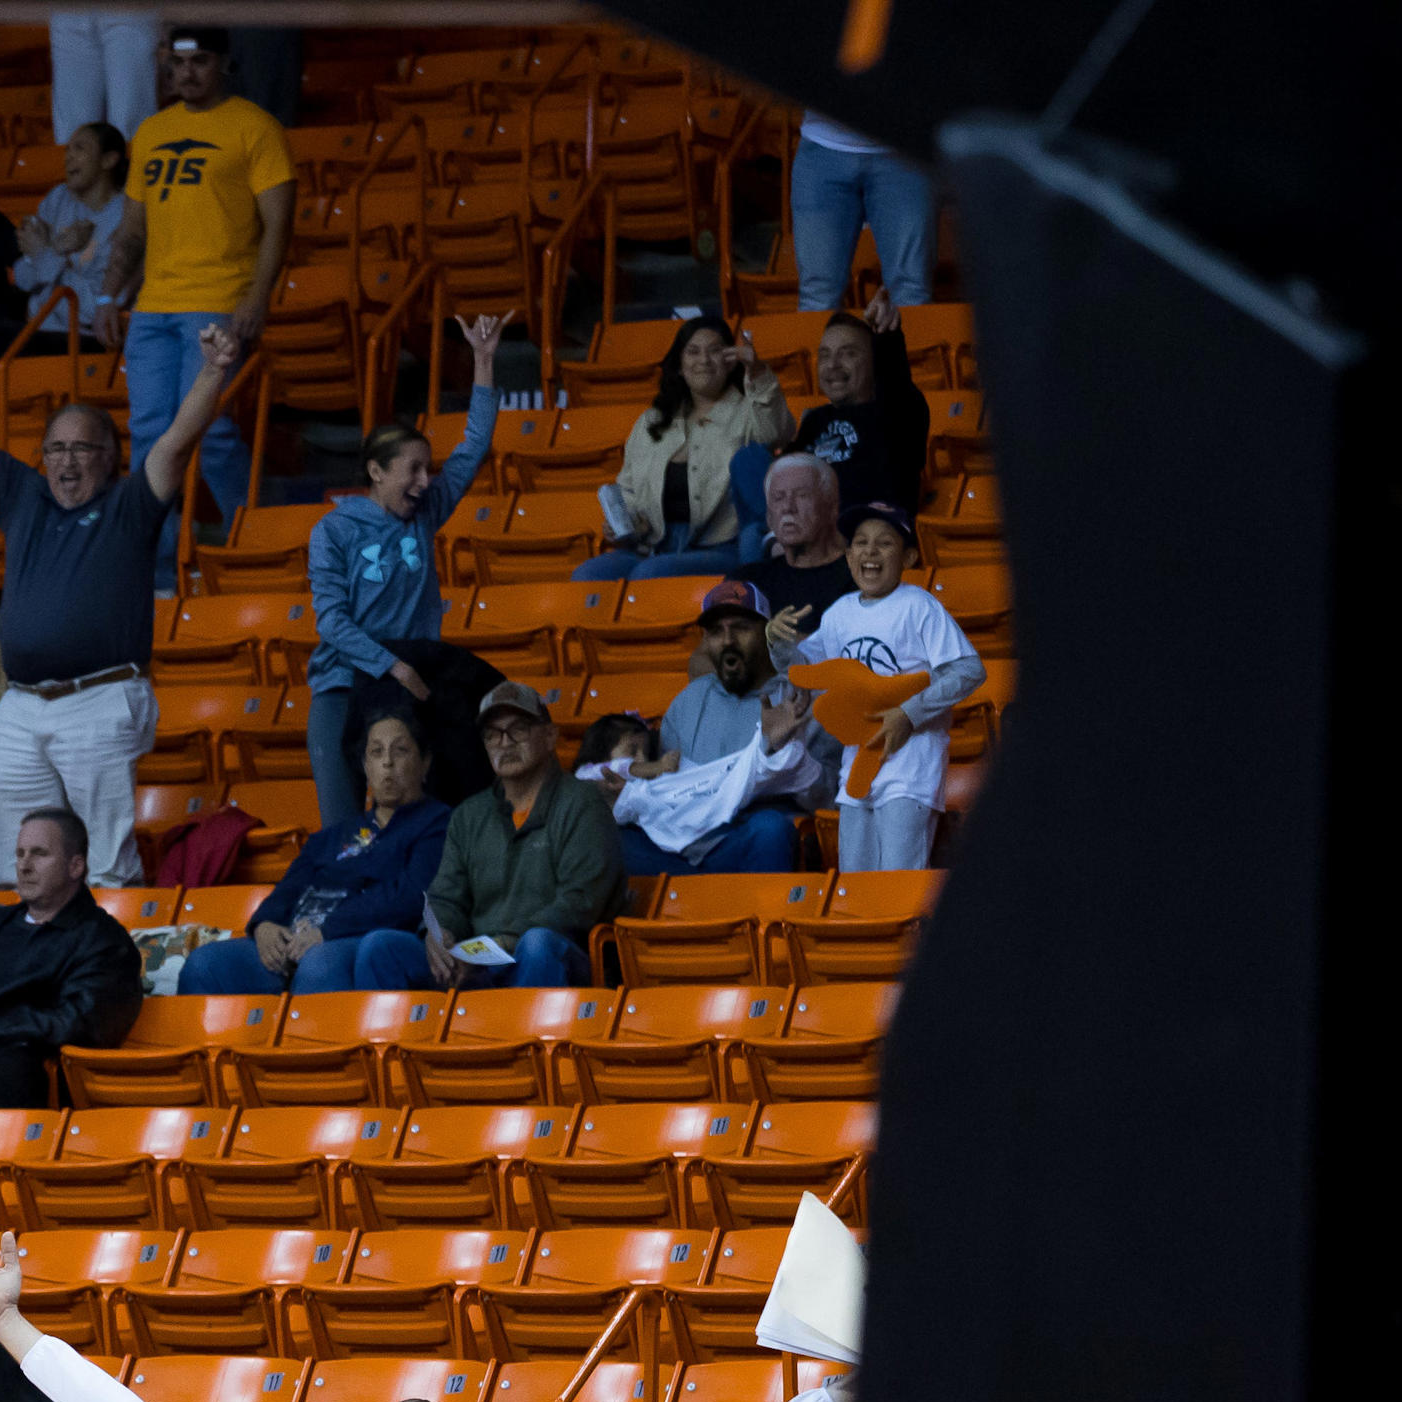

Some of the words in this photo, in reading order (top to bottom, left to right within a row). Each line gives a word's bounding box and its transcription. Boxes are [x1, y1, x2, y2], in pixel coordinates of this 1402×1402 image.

[144, 158, 206, 194] 915
[754, 1000, 766, 1016] 10
[539, 1120, 551, 1136] 10
[715, 1118, 726, 1134] 11
[318, 1245, 330, 1262] 10
[495, 1246, 506, 1262] 11
[675, 1245, 688, 1262] 12
[268, 1375, 280, 1392] 11
[449, 1376, 463, 1393] 12
